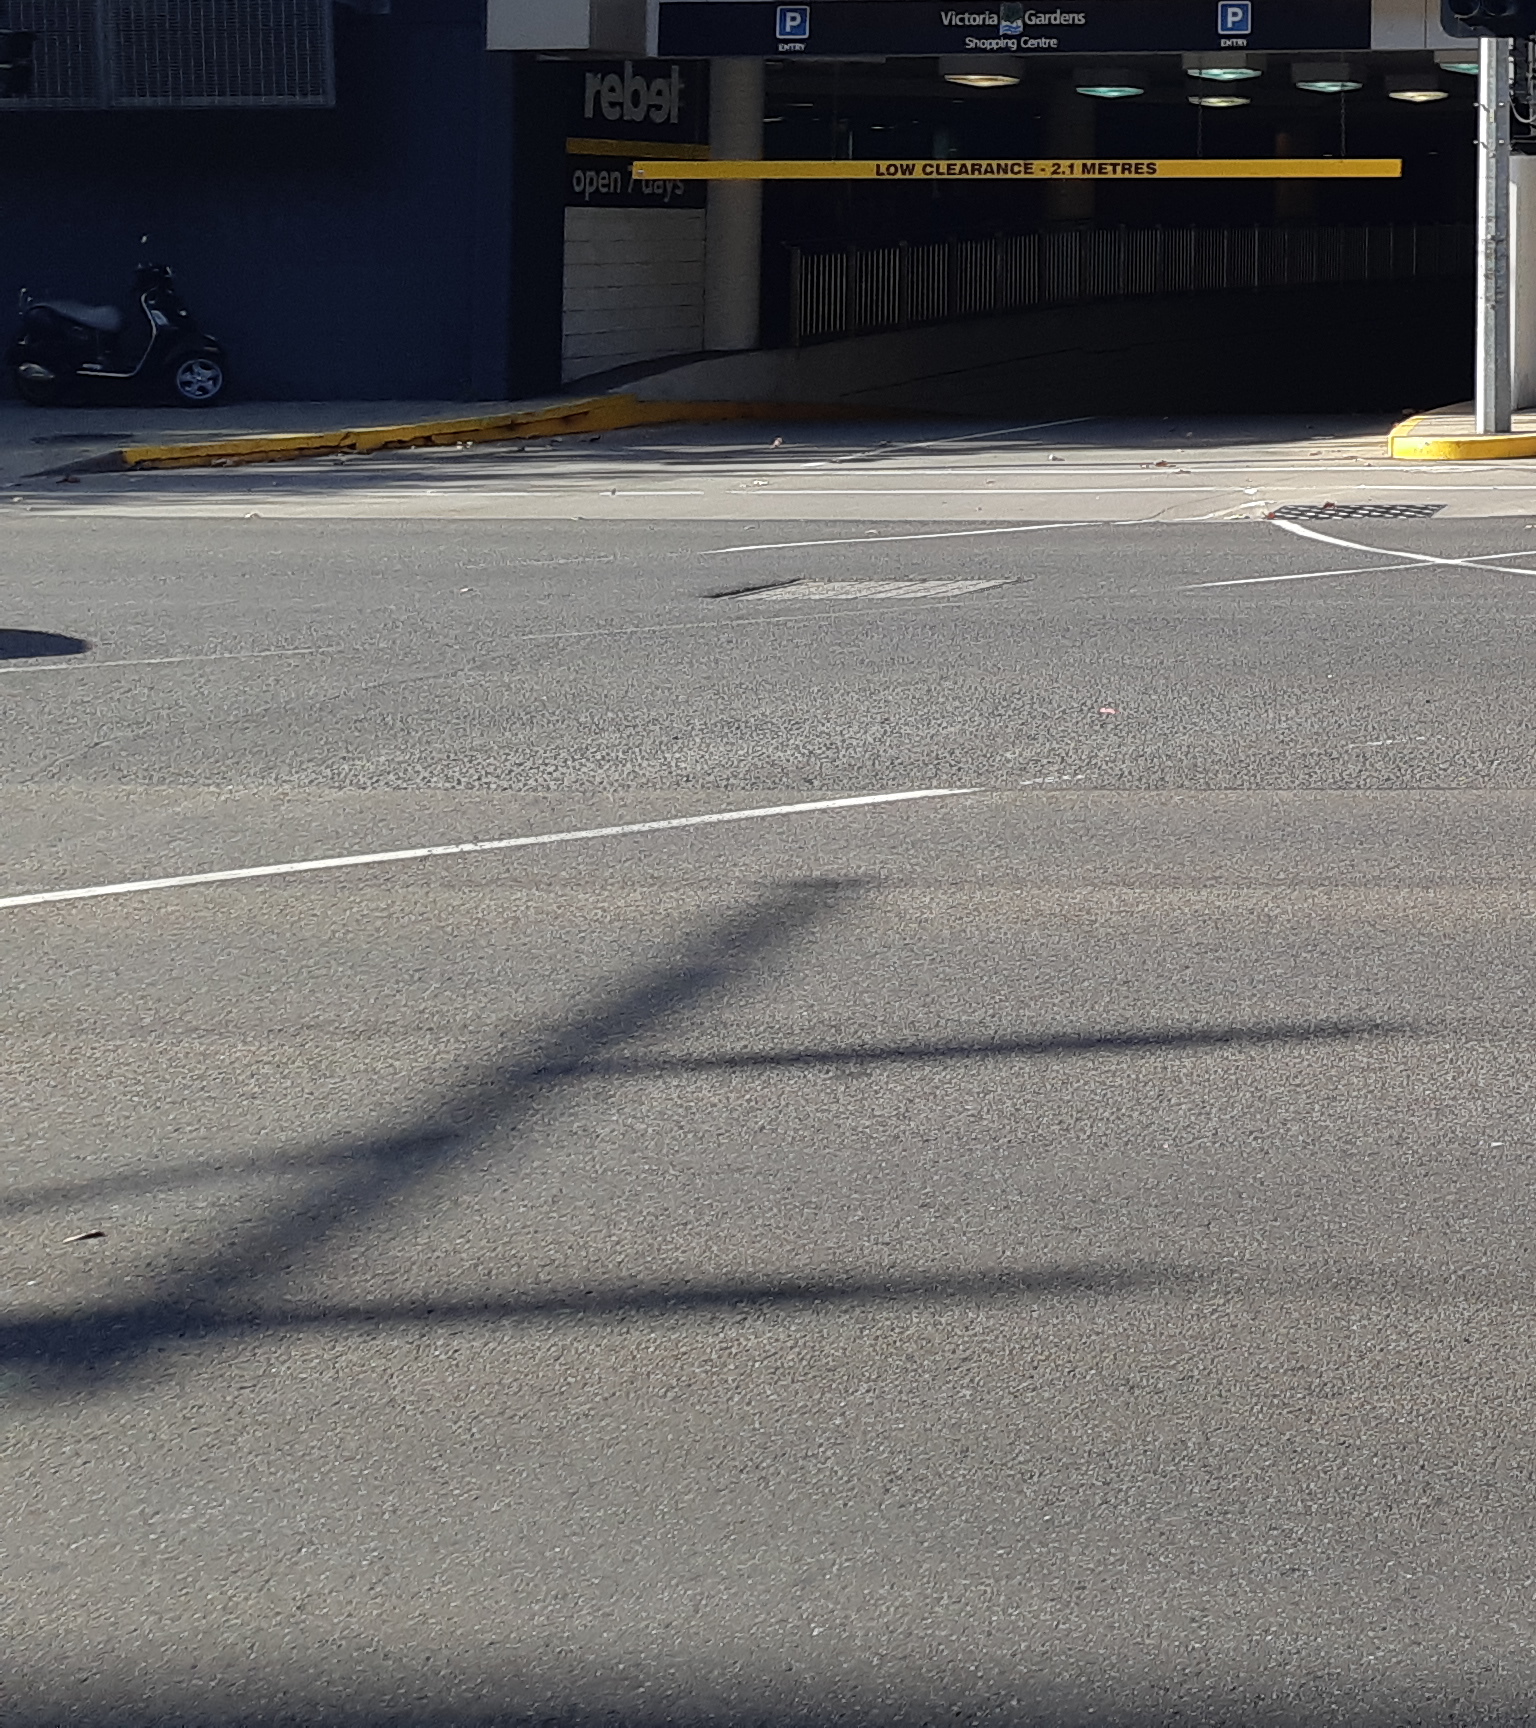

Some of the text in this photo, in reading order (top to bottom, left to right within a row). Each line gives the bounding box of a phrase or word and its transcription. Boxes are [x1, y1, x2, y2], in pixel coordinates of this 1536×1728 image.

[785, 12, 801, 32] P
[941, 10, 1085, 25] Victoria Gardens
[1227, 7, 1242, 28] P
[778, 43, 806, 52] ENTRY
[965, 37, 1058, 50] Shopping Centre
[1220, 39, 1247, 47] ENTRY
[584, 60, 680, 124] rebel
[875, 162, 915, 177] LOW
[922, 162, 1034, 176] CLEARANCE
[1051, 162, 1076, 176] 2.1
[1081, 161, 1157, 175] METRES
[573, 168, 622, 201] open
